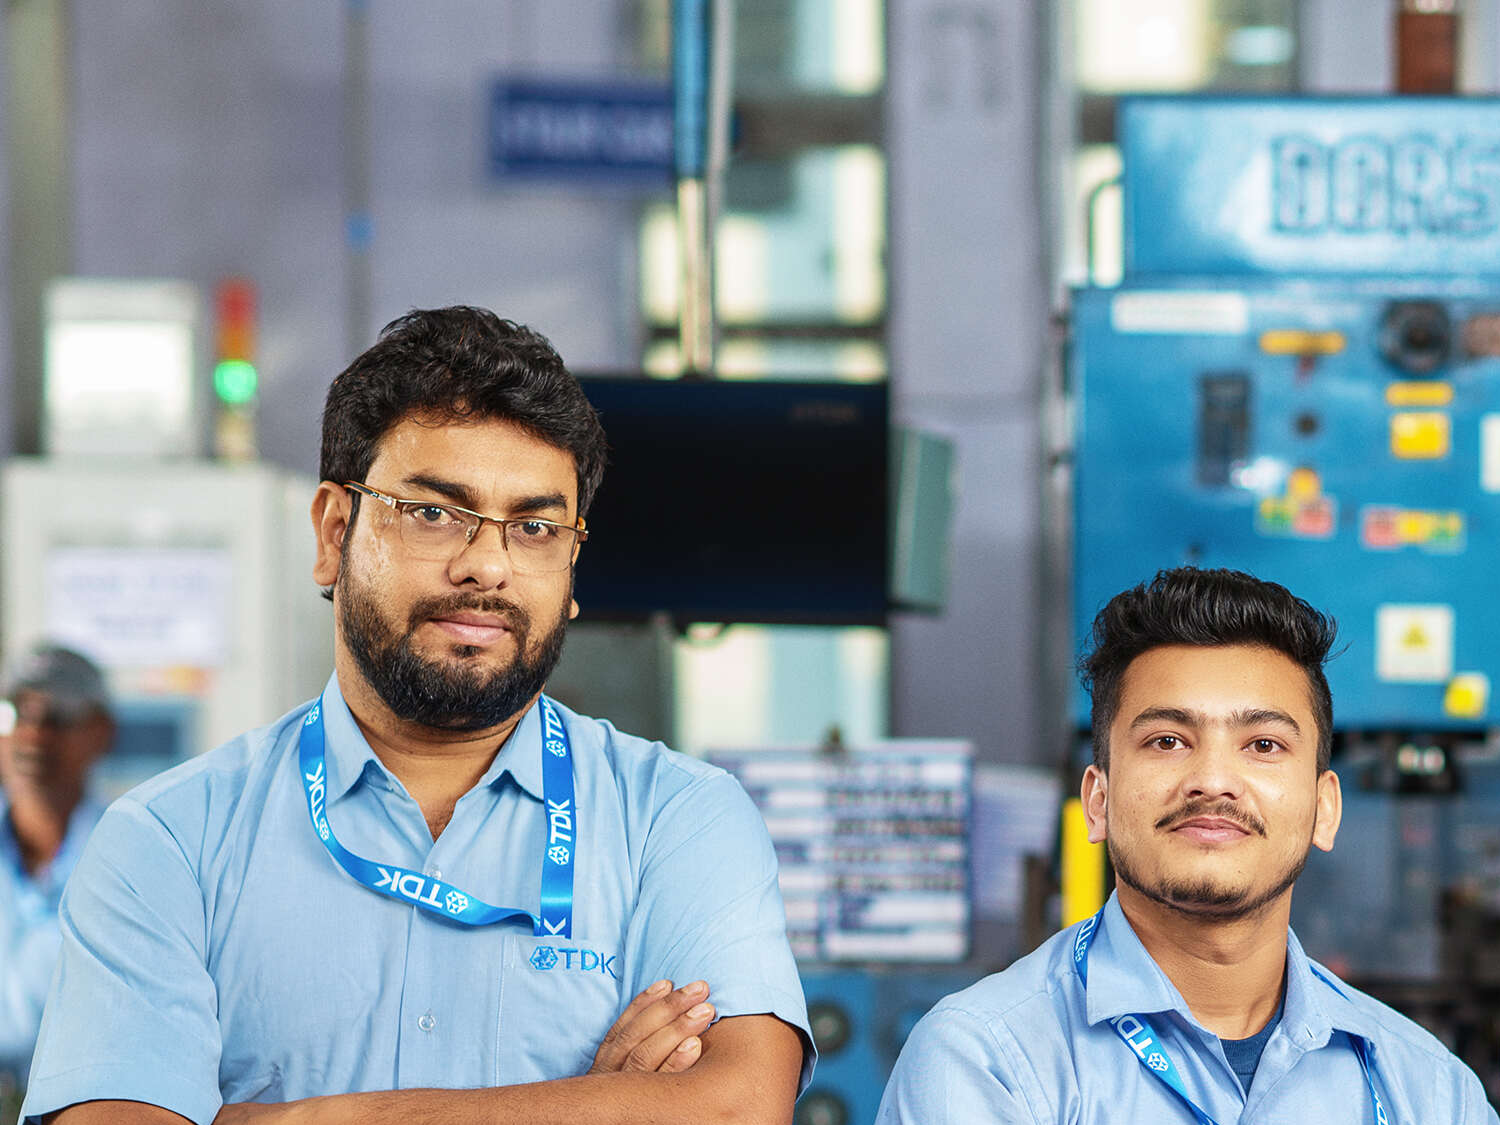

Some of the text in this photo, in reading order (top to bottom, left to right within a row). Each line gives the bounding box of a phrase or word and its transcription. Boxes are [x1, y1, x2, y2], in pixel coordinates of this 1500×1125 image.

[305, 762, 325, 829] TDK
[547, 799, 572, 844] TDK
[373, 866, 443, 909] TDK
[557, 947, 624, 982] TDK
[1110, 1014, 1153, 1059] TD
